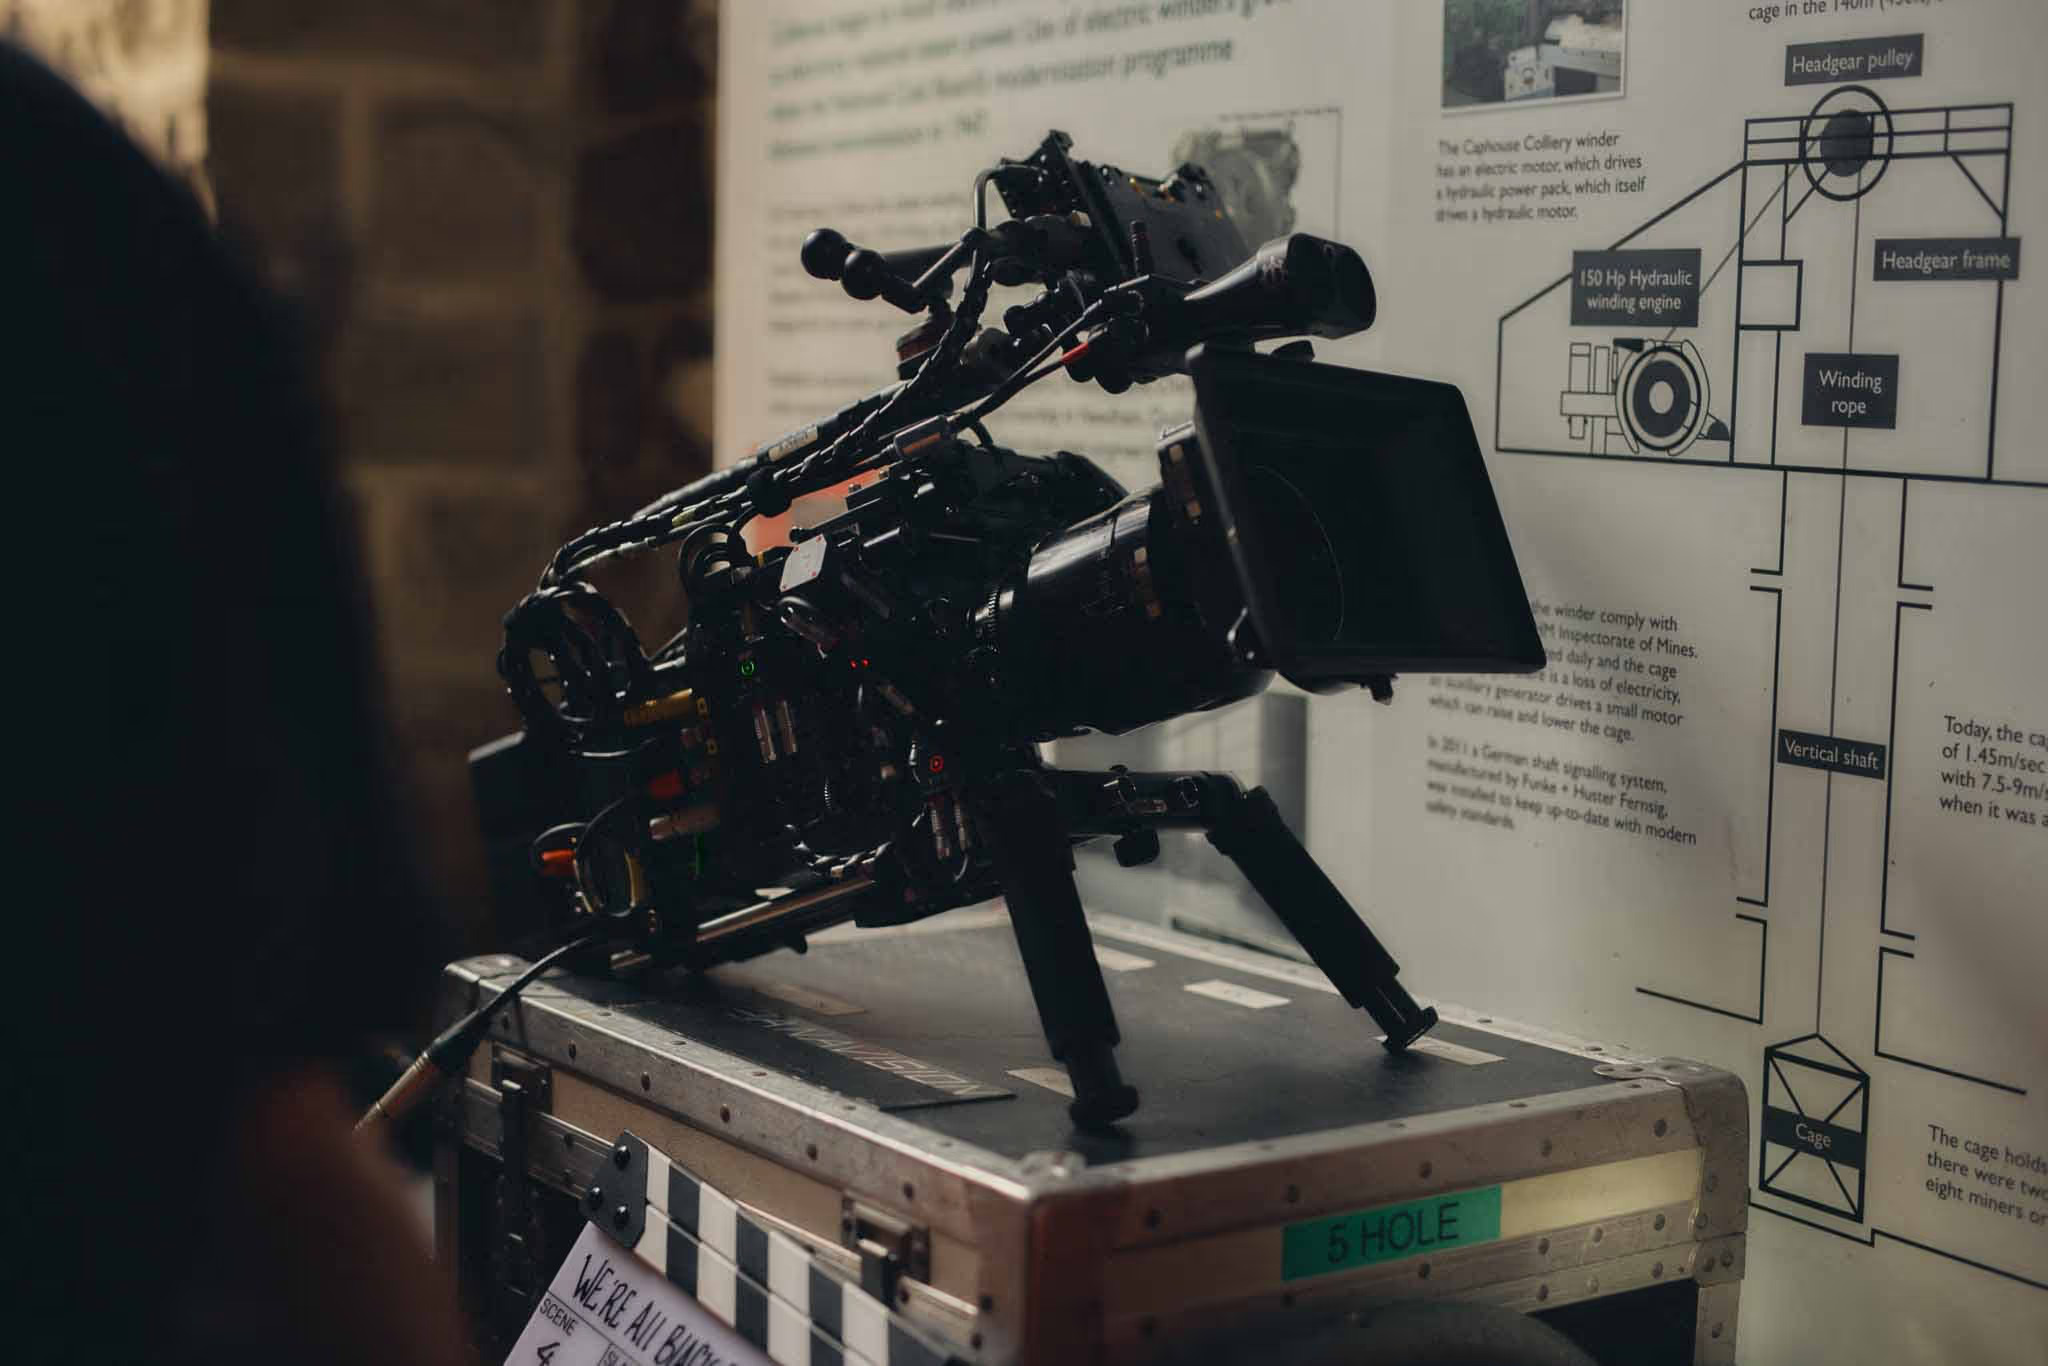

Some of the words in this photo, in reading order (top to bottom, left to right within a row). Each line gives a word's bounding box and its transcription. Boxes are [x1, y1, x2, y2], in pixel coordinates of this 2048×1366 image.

[1749, 4, 1780, 23] cage
[1785, 2, 1797, 17] in
[1802, 0, 1826, 16] the
[1792, 52, 1864, 77] Headgear
[1867, 48, 1915, 73] pulley
[1523, 134, 1573, 153] Colliery
[1576, 131, 1621, 148] winder
[1564, 156, 1600, 172] which
[1604, 153, 1642, 171] drives
[1499, 185, 1538, 203] power
[1574, 177, 1611, 195] which
[1615, 175, 1647, 194] itself
[1882, 251, 1958, 274] Headgear
[1962, 249, 2011, 269] frame
[1580, 269, 1602, 287] 150
[1606, 269, 1627, 291] Hp
[1630, 268, 1693, 291] Hydraulic
[1587, 293, 1636, 315] winding
[1640, 294, 1682, 315] engine
[1819, 369, 1883, 394] Winding
[1831, 399, 1867, 419] rope
[1554, 602, 1596, 622] winder
[1601, 606, 1645, 633] comply
[1649, 613, 1678, 633] with
[1559, 625, 1636, 651] Inspectorate
[1640, 634, 1653, 652] of
[1656, 635, 1699, 660] Mines.
[1567, 648, 1593, 670] daily
[1597, 653, 1620, 672] and
[1623, 657, 1645, 676] the
[1648, 662, 1678, 682] cage
[1573, 671, 1595, 690] loss
[1600, 674, 1614, 692] of
[1616, 676, 1681, 705] electricity,
[1556, 689, 1592, 712] drives
[1607, 699, 1638, 719] small
[1642, 708, 1684, 727] motor
[1542, 711, 1576, 731] lower
[1579, 717, 1600, 737] the
[1604, 723, 1635, 744] cage.
[1944, 714, 1994, 742] Today,
[1997, 723, 2024, 744] the
[2029, 731, 2048, 750] ca
[1784, 736, 1840, 764] Vertical
[1843, 750, 1880, 771] shaft
[1942, 743, 1958, 762] of
[1563, 761, 1617, 787] signalling
[1619, 773, 1668, 796] system,
[1573, 783, 1617, 806] Huster
[1940, 768, 1976, 790] with
[1546, 803, 1611, 829] up-to-date
[1614, 813, 1642, 836] with
[1645, 822, 1698, 846] modern
[1939, 794, 1983, 818] when
[1989, 799, 2001, 820] it
[2005, 806, 2037, 828] was
[1795, 1123, 1832, 1150] Cage
[1928, 1123, 1959, 1150] The
[1964, 1137, 2000, 1163] cage
[1927, 1151, 1969, 1178] there
[1974, 1167, 2016, 1191] were
[1925, 1177, 1964, 1202] eight
[1969, 1190, 2024, 1220] miners
[1327, 1222, 1349, 1264] 5
[1360, 1201, 1460, 1257] HOLE
[539, 1298, 579, 1337] SCENE
